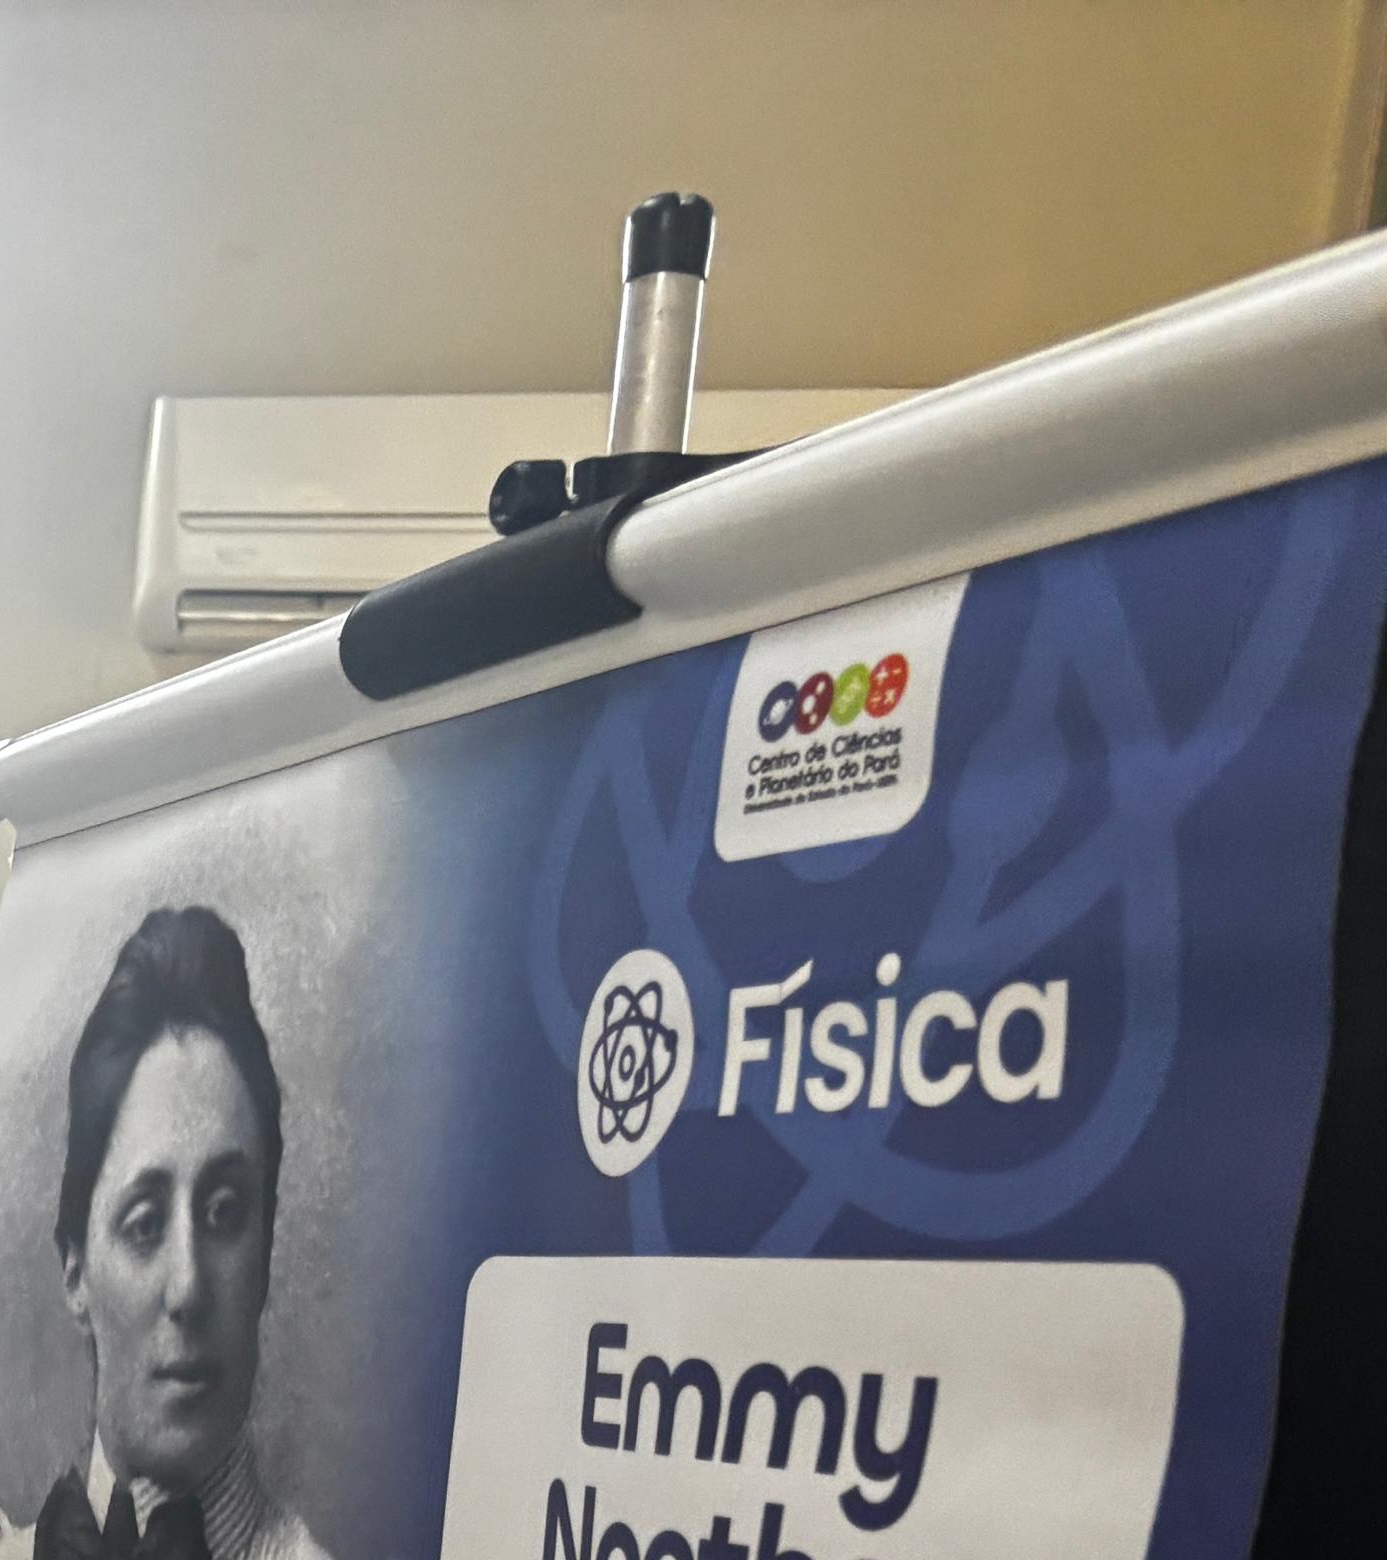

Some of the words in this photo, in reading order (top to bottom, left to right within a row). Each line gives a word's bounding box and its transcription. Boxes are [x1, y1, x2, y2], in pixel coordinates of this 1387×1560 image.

[745, 784, 755, 799] e
[758, 766, 833, 796] Planetário
[837, 760, 860, 780] do
[862, 749, 901, 776] Pará
[748, 749, 801, 776] Centro
[805, 743, 826, 763] de
[831, 727, 902, 757] Ciências
[717, 952, 1068, 1117] Física
[581, 1321, 938, 1531] Emmy
